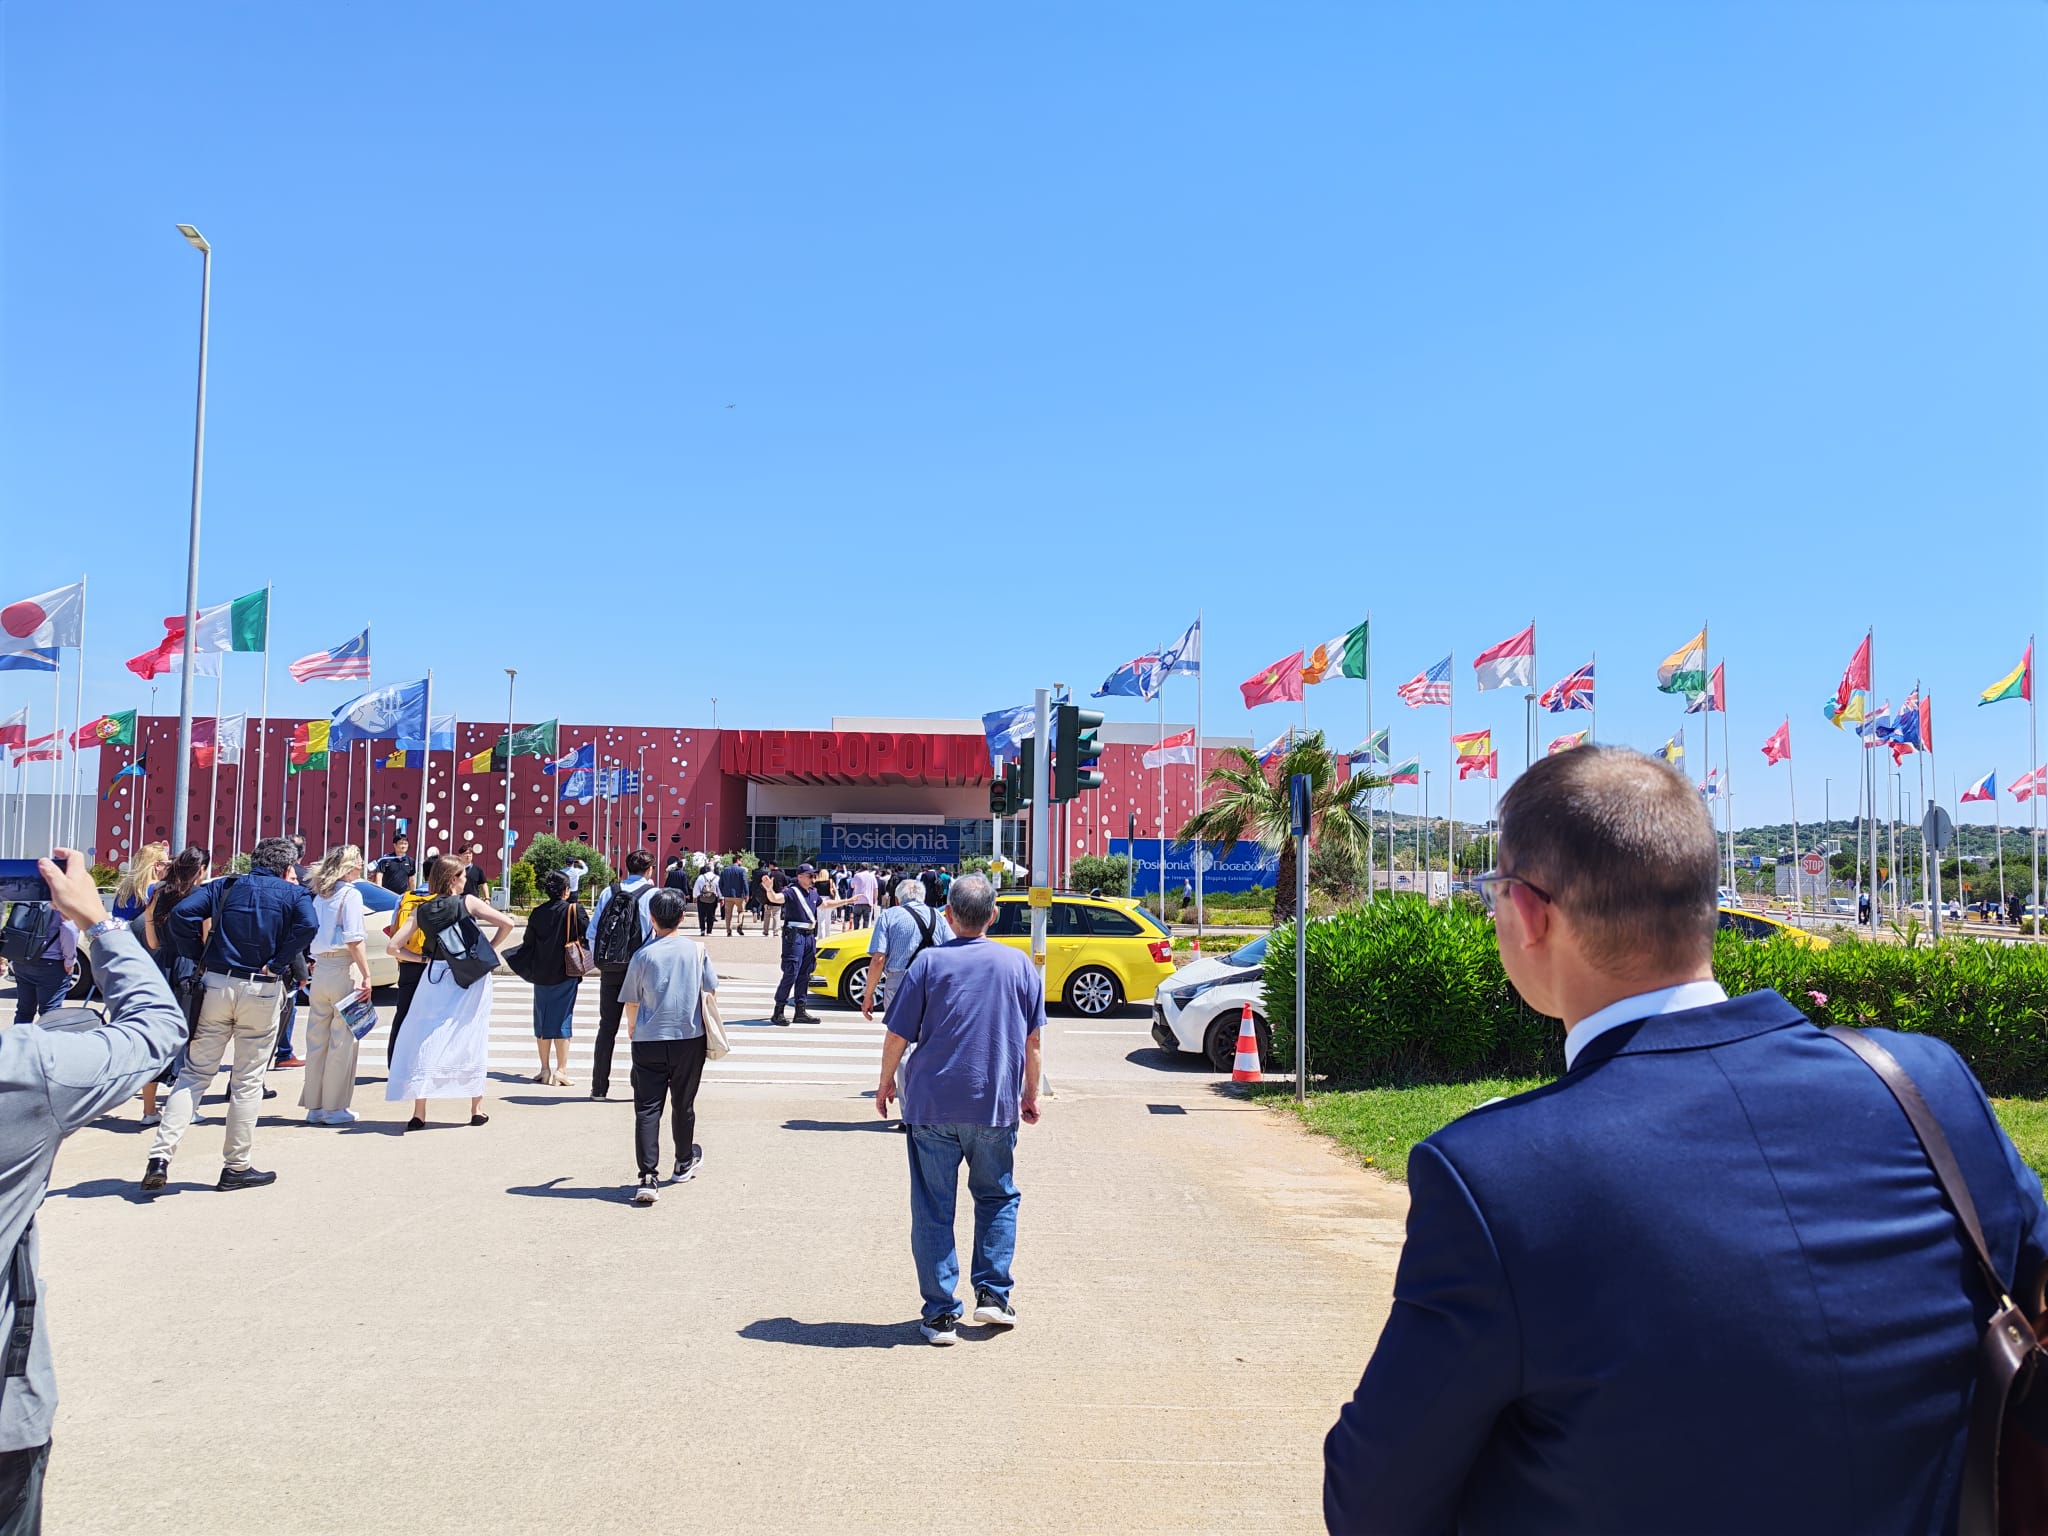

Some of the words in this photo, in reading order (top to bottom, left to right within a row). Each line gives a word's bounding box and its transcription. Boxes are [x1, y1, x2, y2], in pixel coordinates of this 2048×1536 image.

[831, 826, 949, 850] Posidonia
[840, 854, 875, 862] Welcome
[885, 855, 918, 863] Posidonia
[919, 855, 937, 863] 2026
[1803, 859, 1824, 871] STOP
